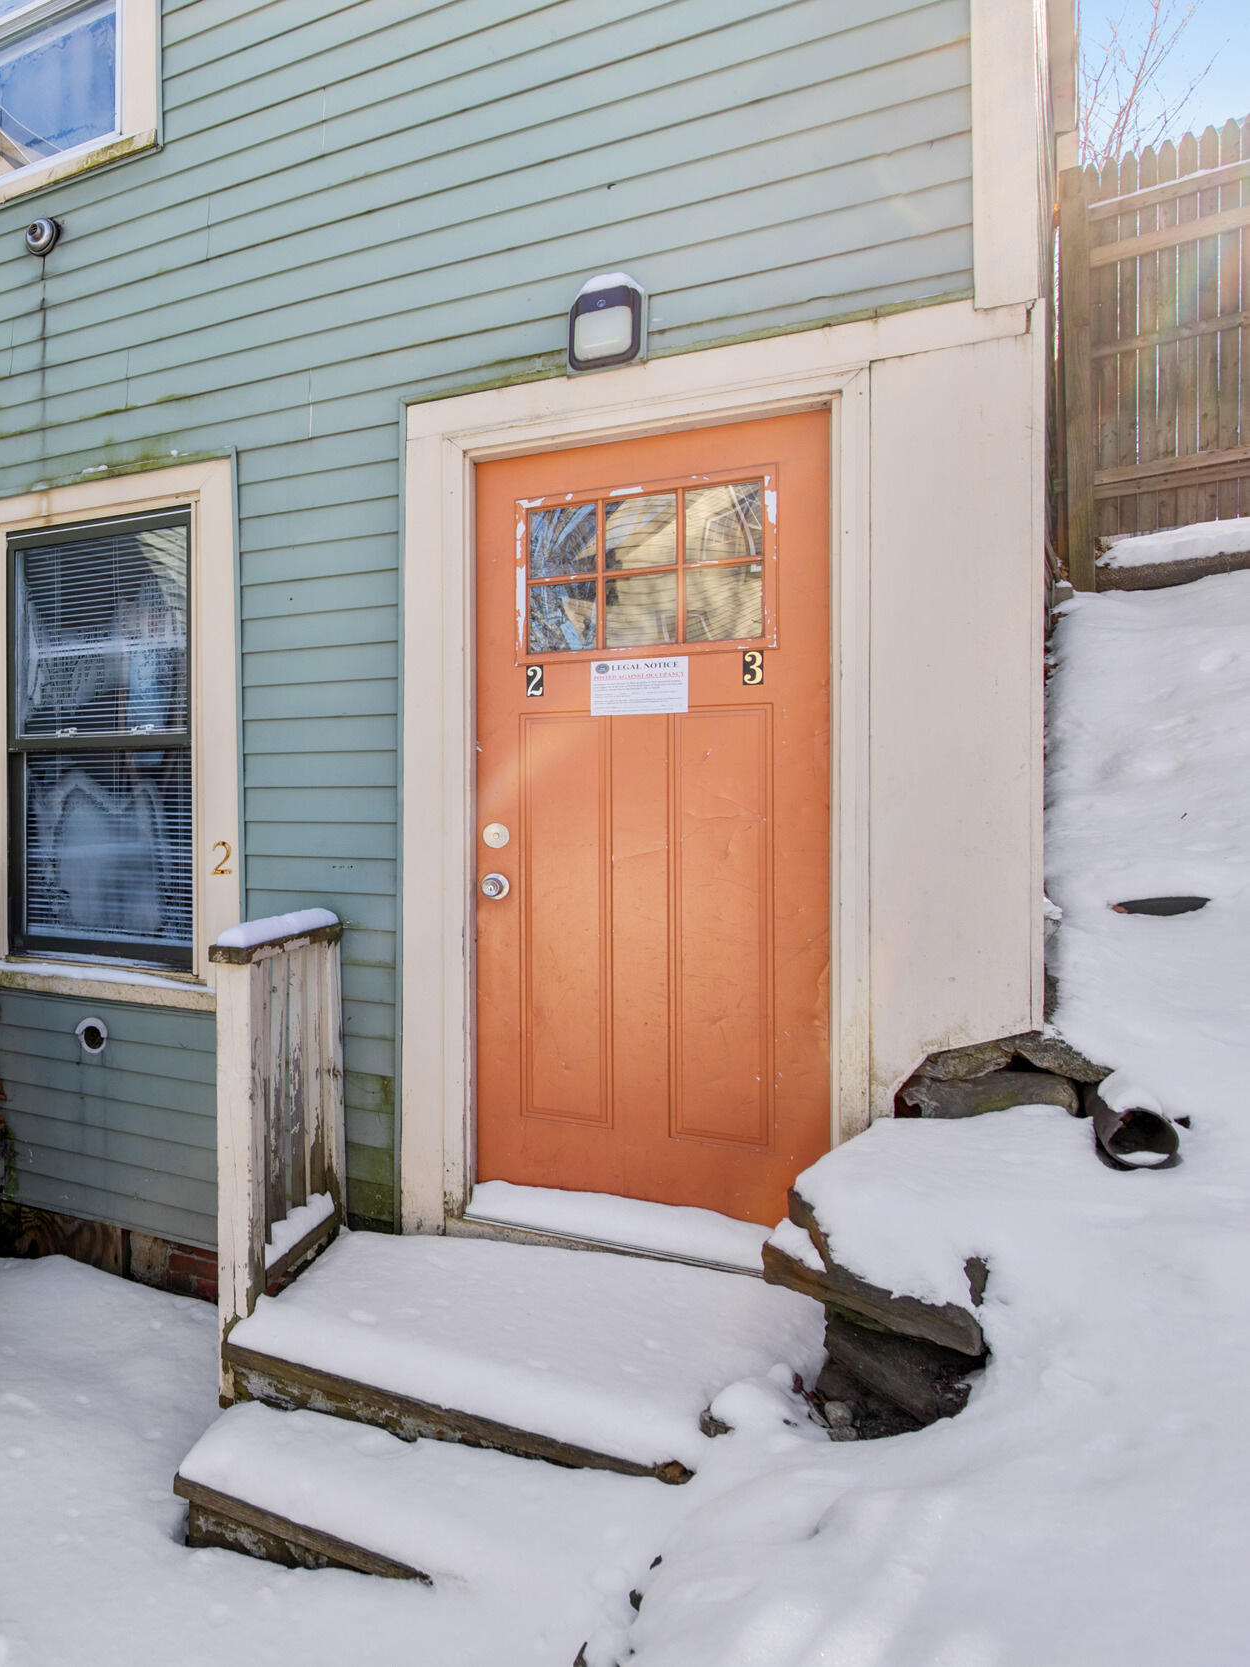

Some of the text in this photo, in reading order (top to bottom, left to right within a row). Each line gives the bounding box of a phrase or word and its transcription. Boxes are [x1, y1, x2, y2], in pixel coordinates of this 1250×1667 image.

[527, 666, 543, 697] 2
[611, 661, 679, 671] LEGAL NOTICE
[744, 651, 763, 684] 3
[211, 841, 232, 875] 2
